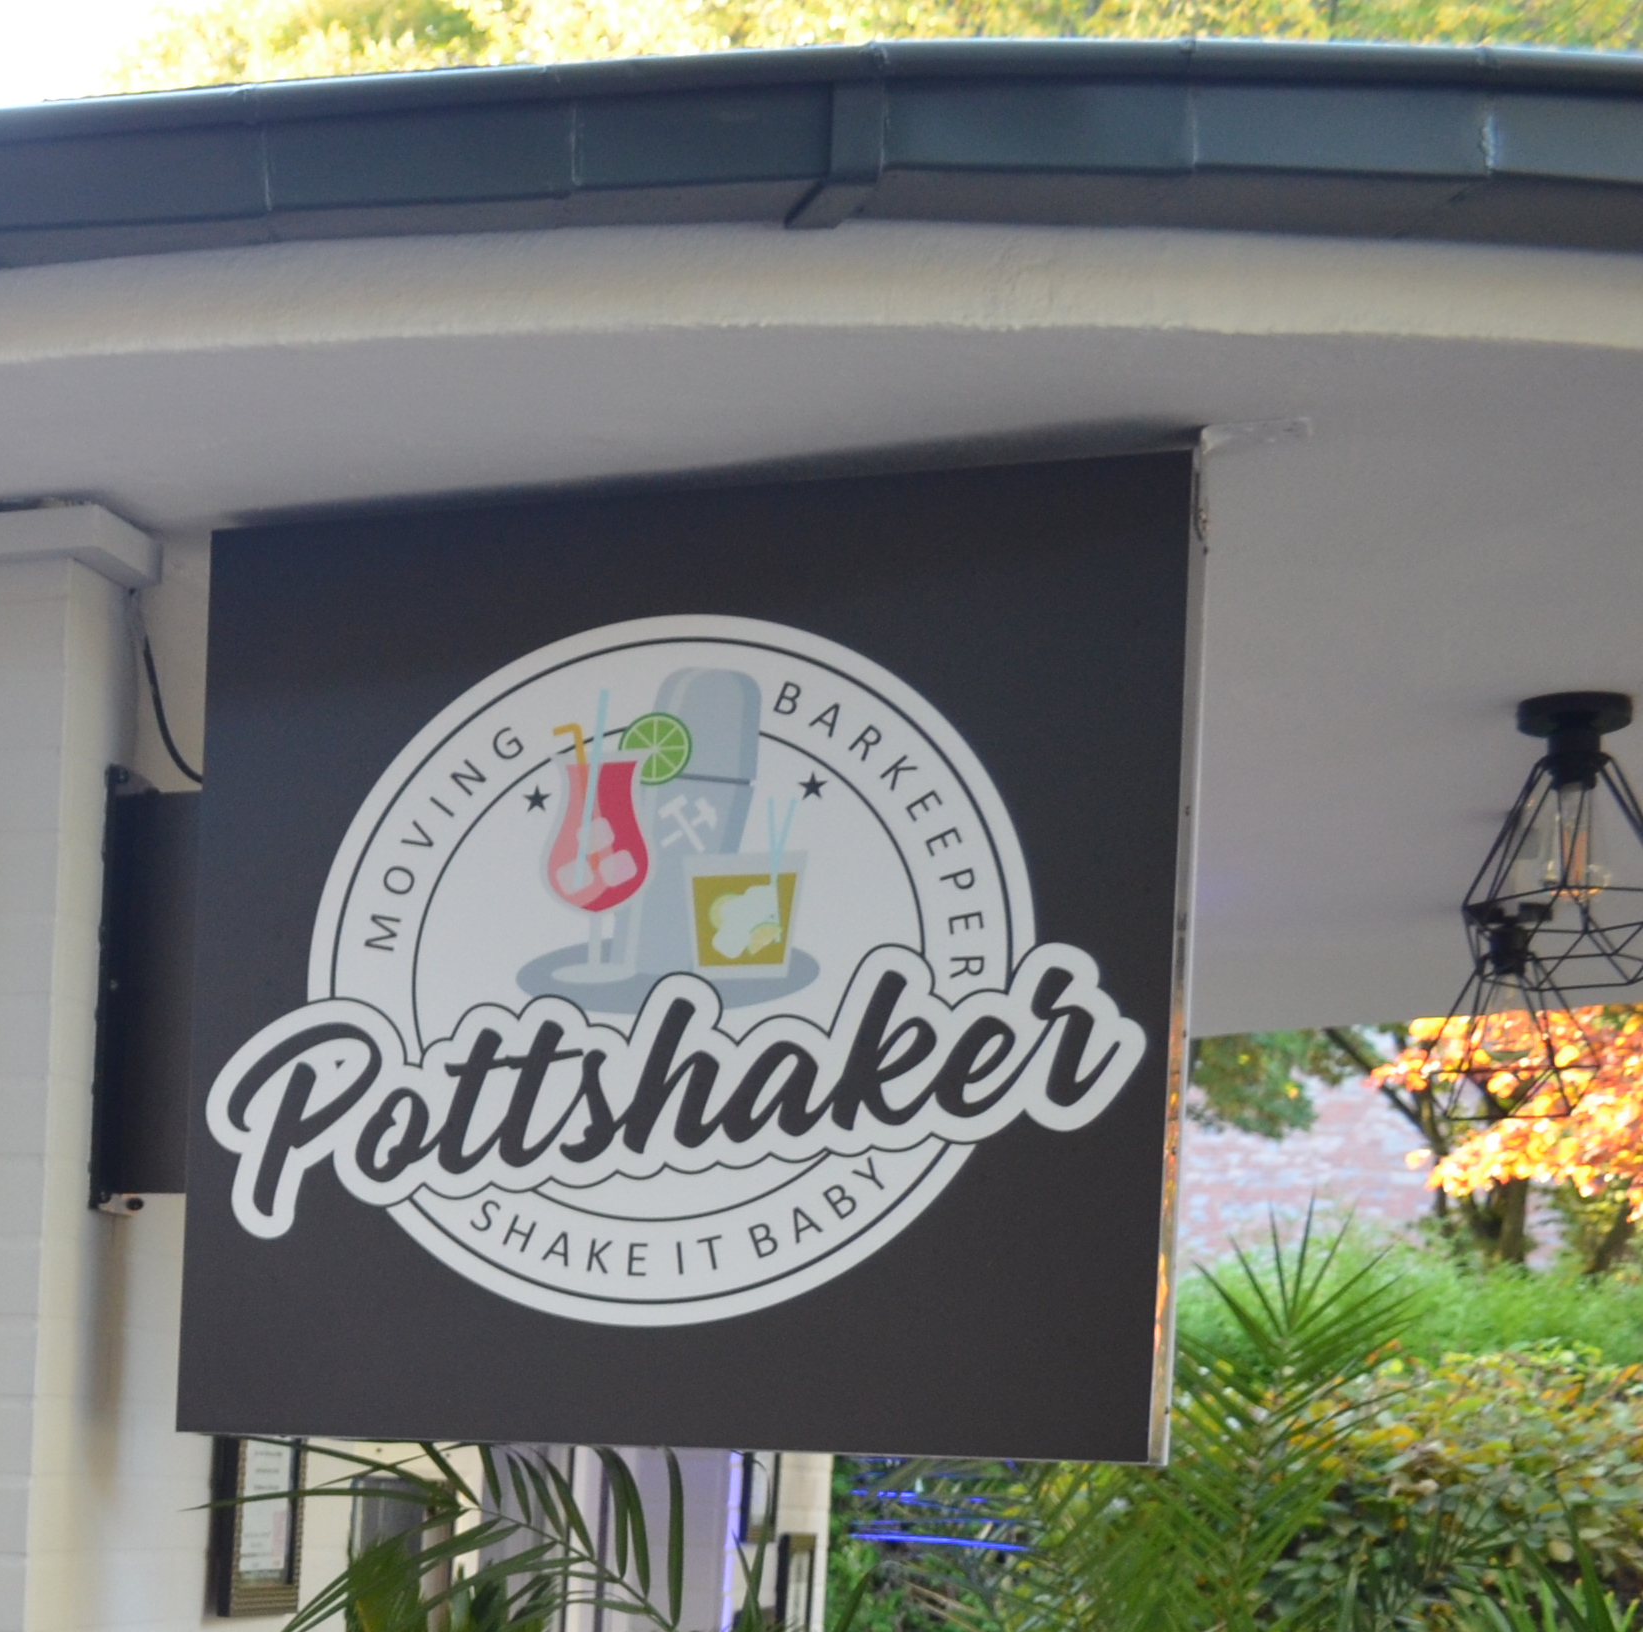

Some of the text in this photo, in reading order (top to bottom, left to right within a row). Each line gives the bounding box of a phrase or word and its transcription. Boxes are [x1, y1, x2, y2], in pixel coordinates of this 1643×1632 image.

[364, 681, 985, 979] MOVING BARKEEPER
[226, 966, 1121, 1218] Pottshaker
[470, 1156, 886, 1276] SHAKE IT BABY
